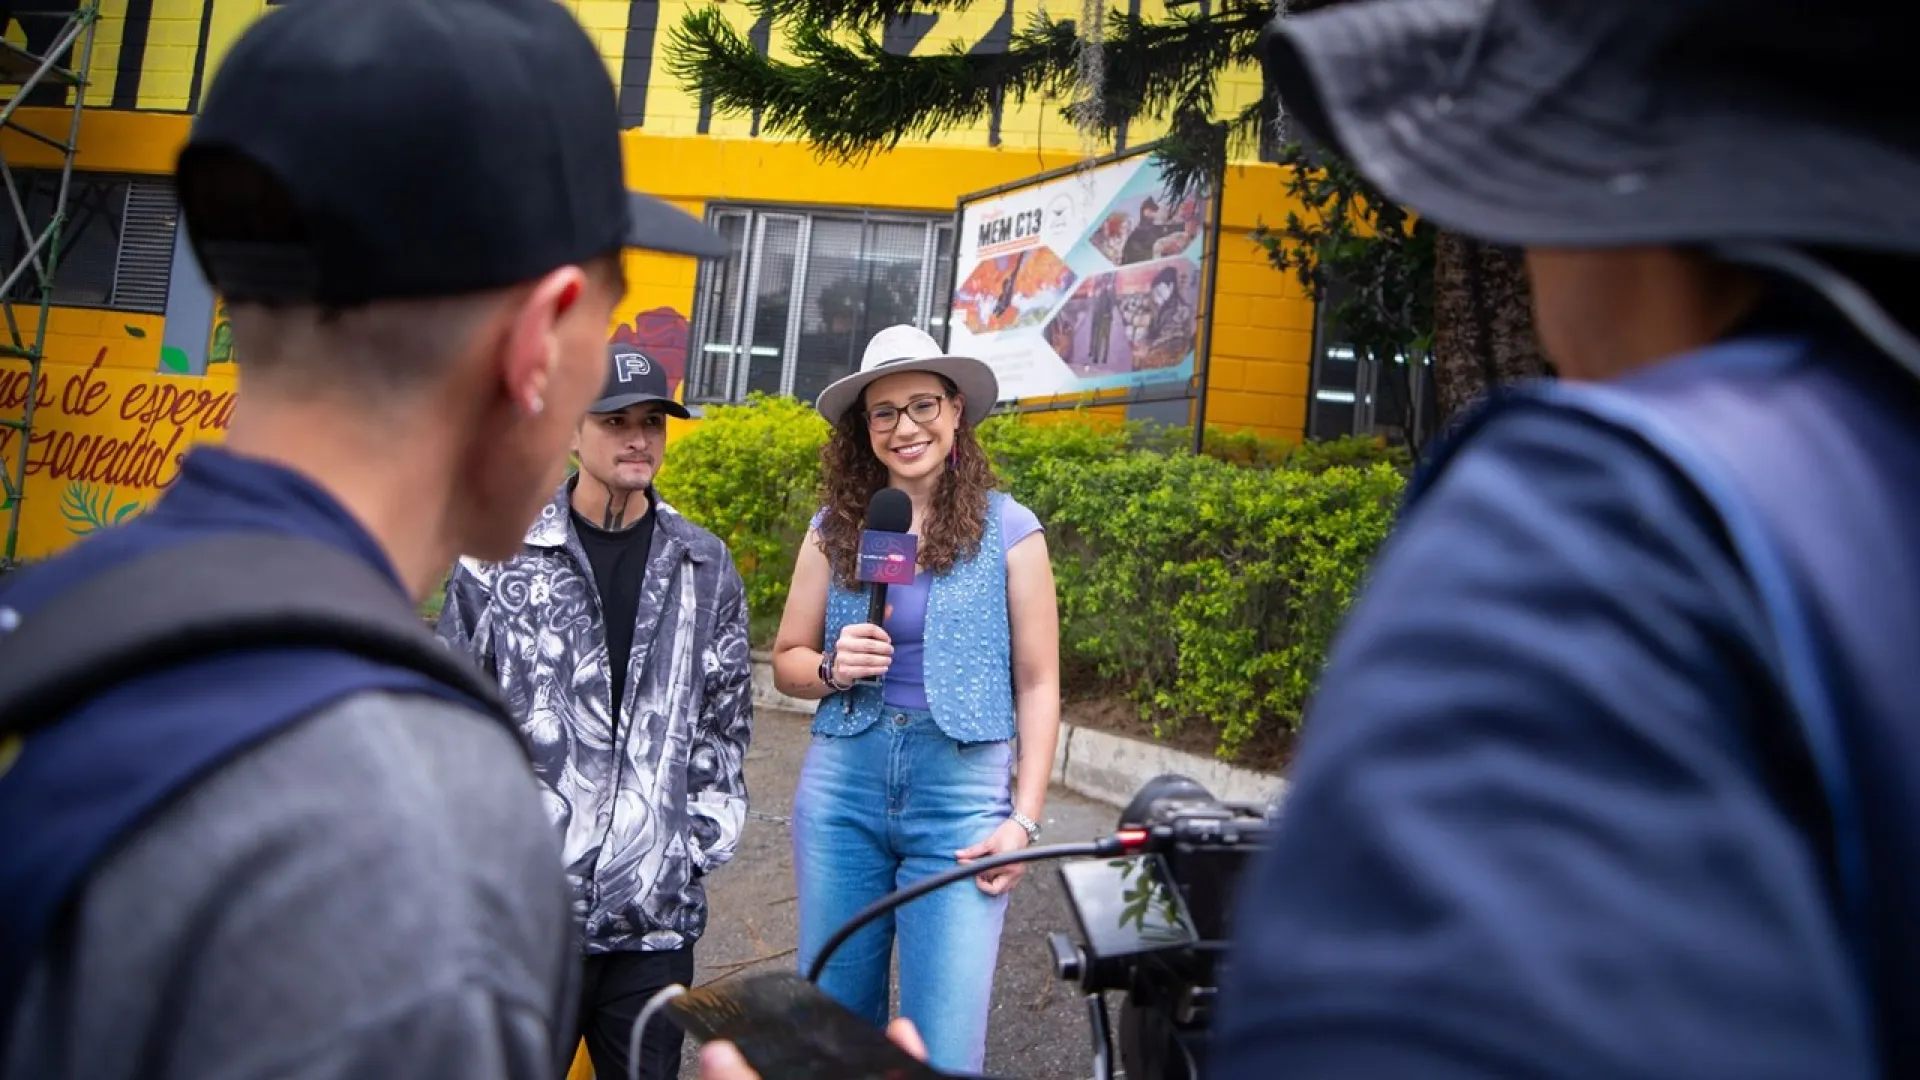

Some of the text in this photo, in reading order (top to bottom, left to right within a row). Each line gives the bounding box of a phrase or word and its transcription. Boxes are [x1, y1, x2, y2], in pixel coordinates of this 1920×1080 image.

[978, 215, 1012, 247] MEM
[1015, 208, 1043, 238] C13
[62, 346, 111, 416] de
[614, 353, 651, 383] P
[25, 426, 183, 489] sociedad
